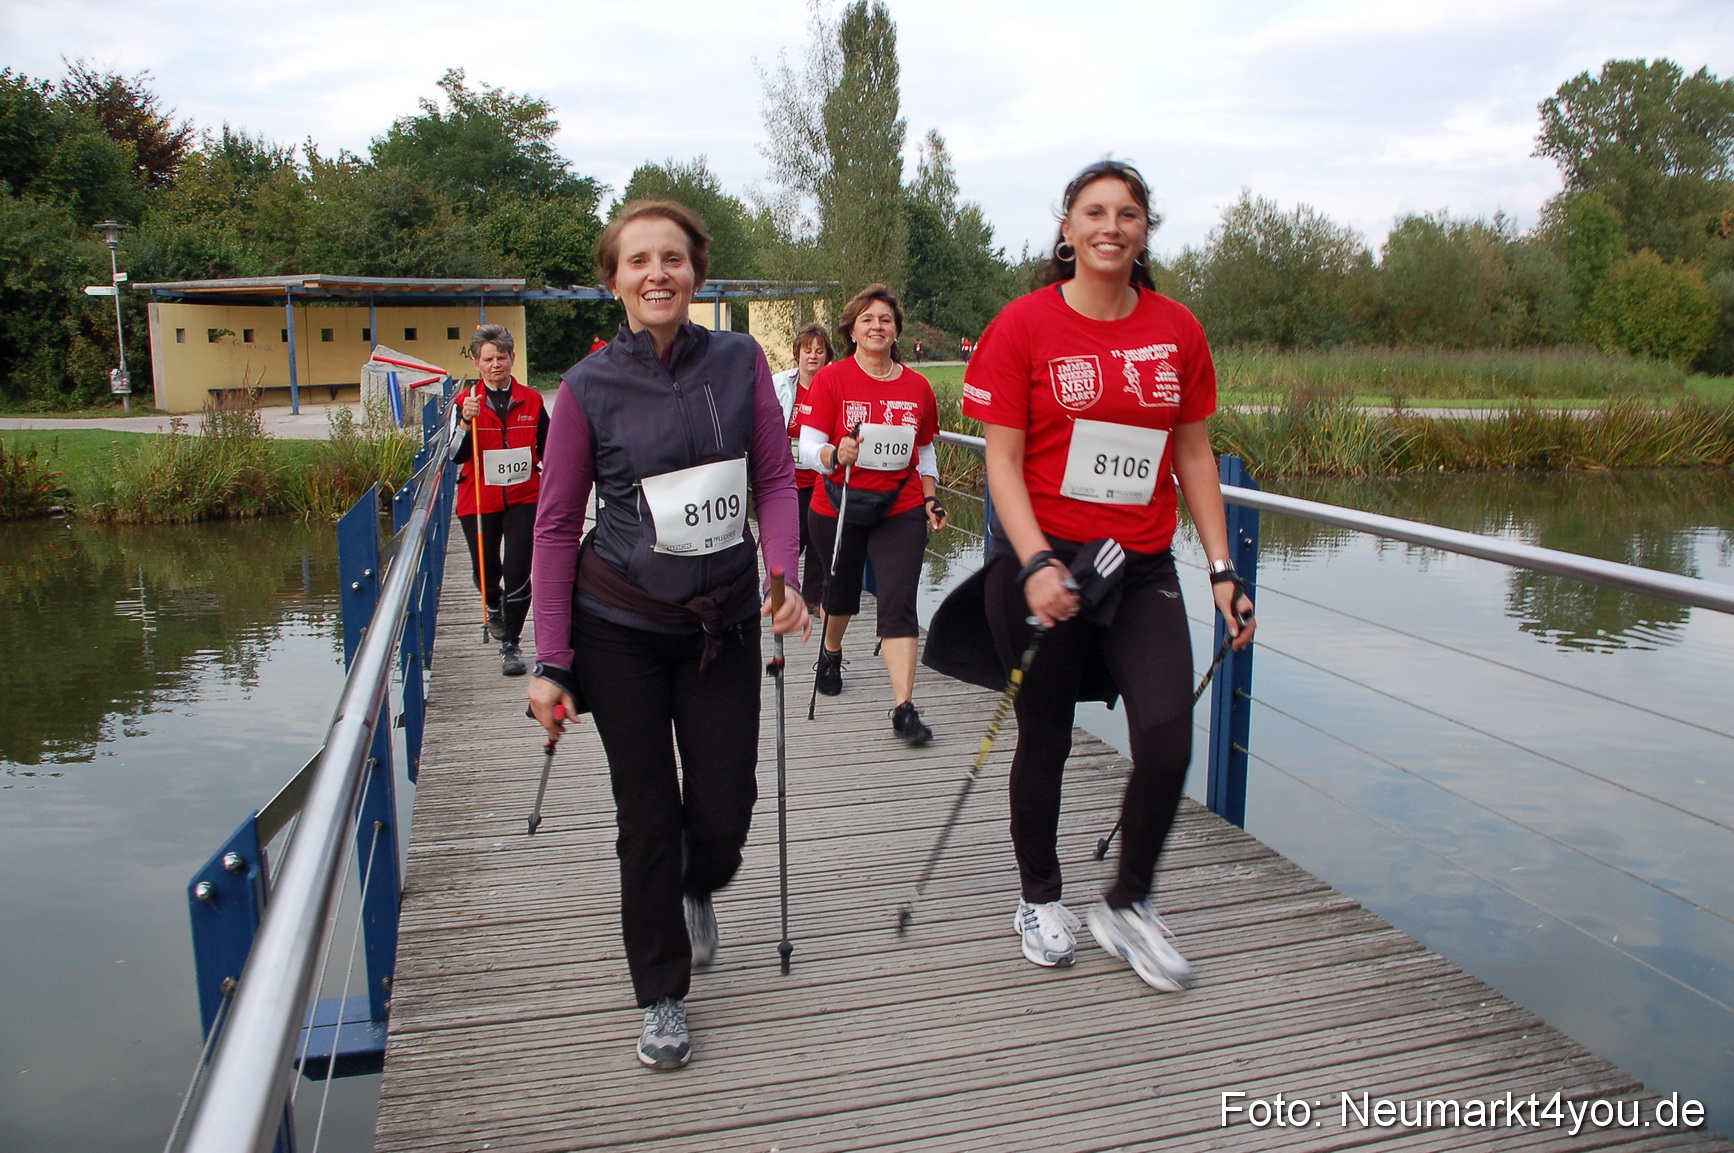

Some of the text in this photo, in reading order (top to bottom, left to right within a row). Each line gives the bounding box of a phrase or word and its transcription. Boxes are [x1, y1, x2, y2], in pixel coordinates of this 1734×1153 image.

[1057, 361, 1094, 374] IMMER
[1056, 369, 1097, 382] WIEDER
[1060, 378, 1096, 394] NEU
[1061, 390, 1096, 404] MARKT
[874, 442, 909, 456] 8108
[497, 461, 528, 475] 8102
[1093, 453, 1151, 479] 8106
[684, 494, 740, 527] 8109
